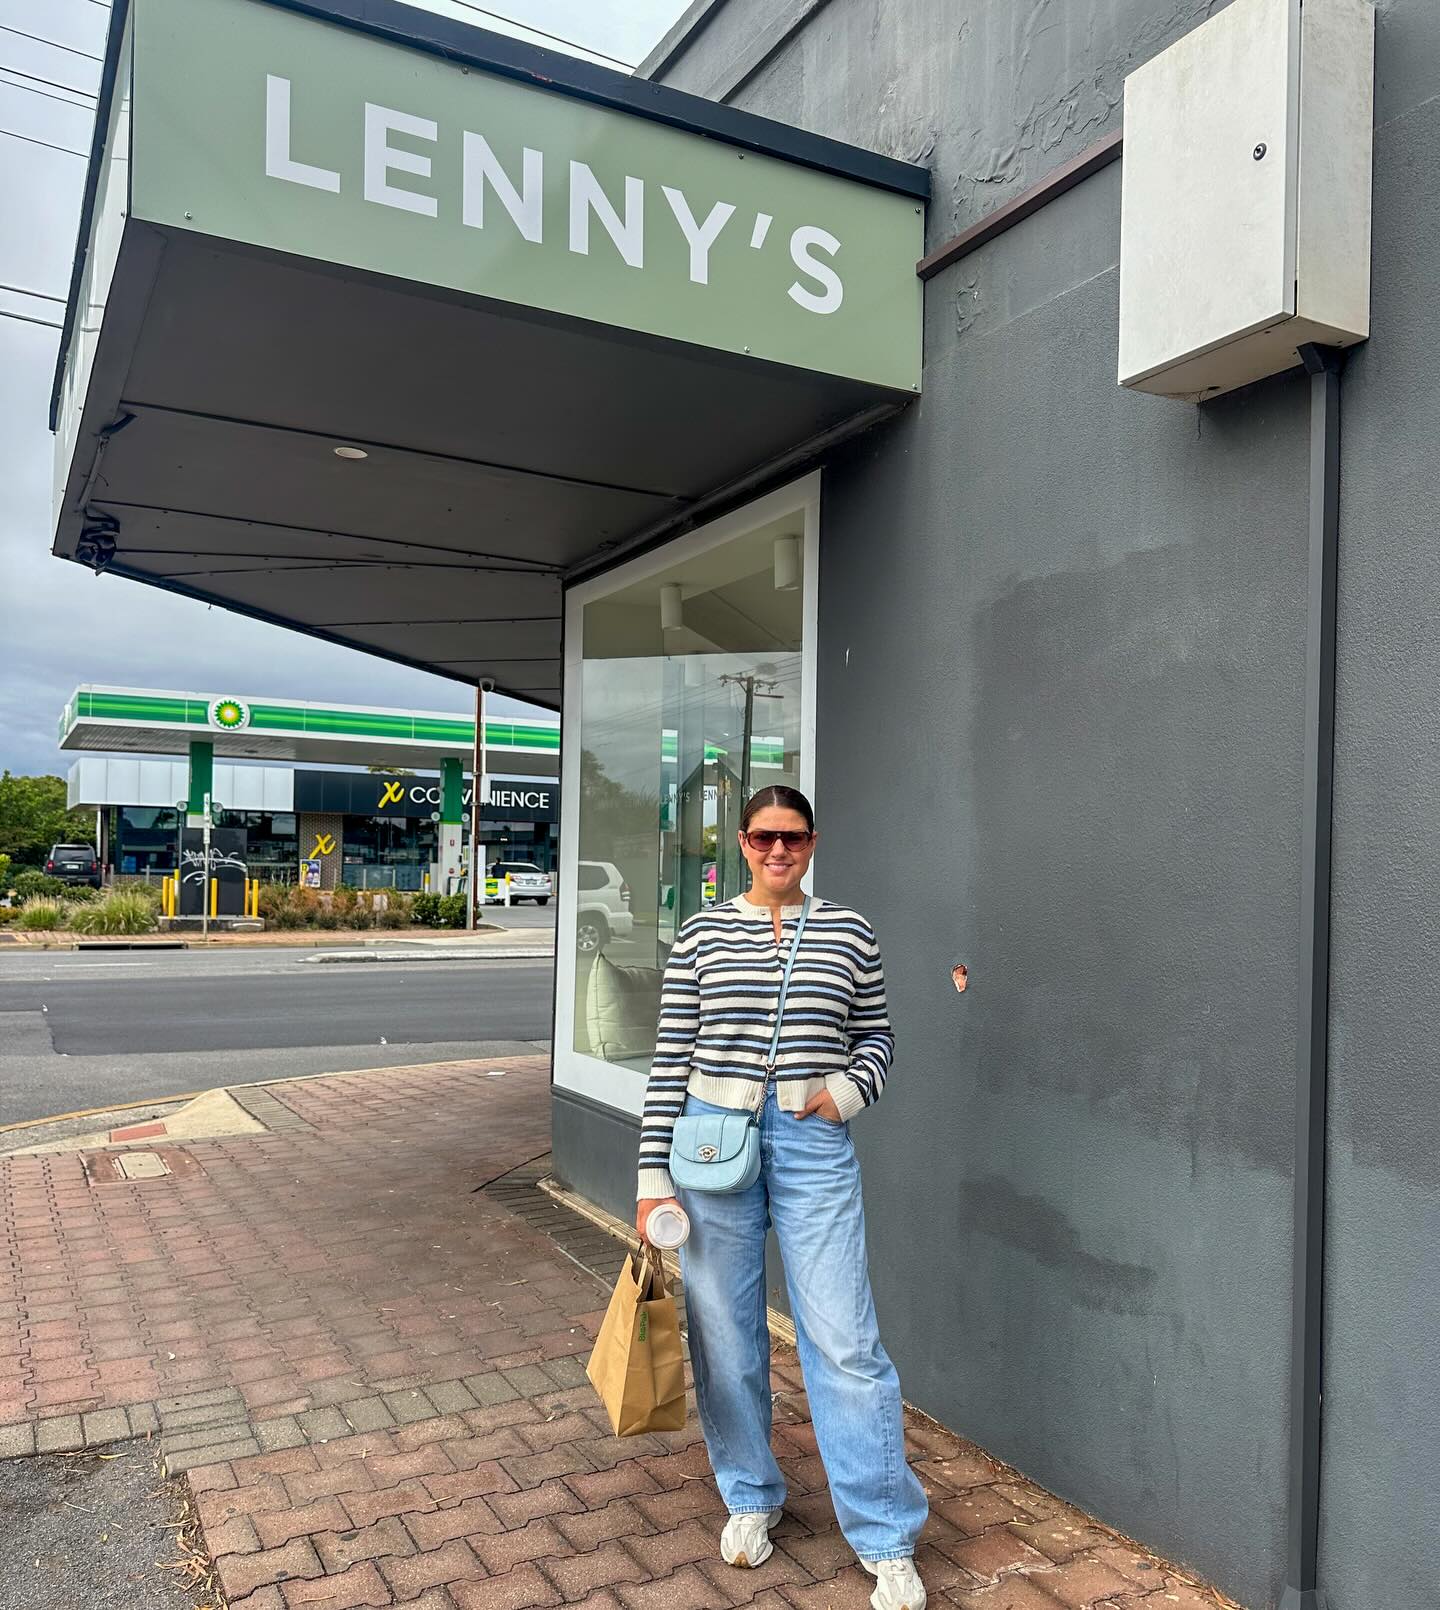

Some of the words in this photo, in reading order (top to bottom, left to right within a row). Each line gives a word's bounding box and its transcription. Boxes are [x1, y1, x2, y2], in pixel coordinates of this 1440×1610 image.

[265, 73, 844, 316] LENNY'S
[409, 786, 550, 809] COVNIENCE
[698, 789, 732, 801] LENNS
